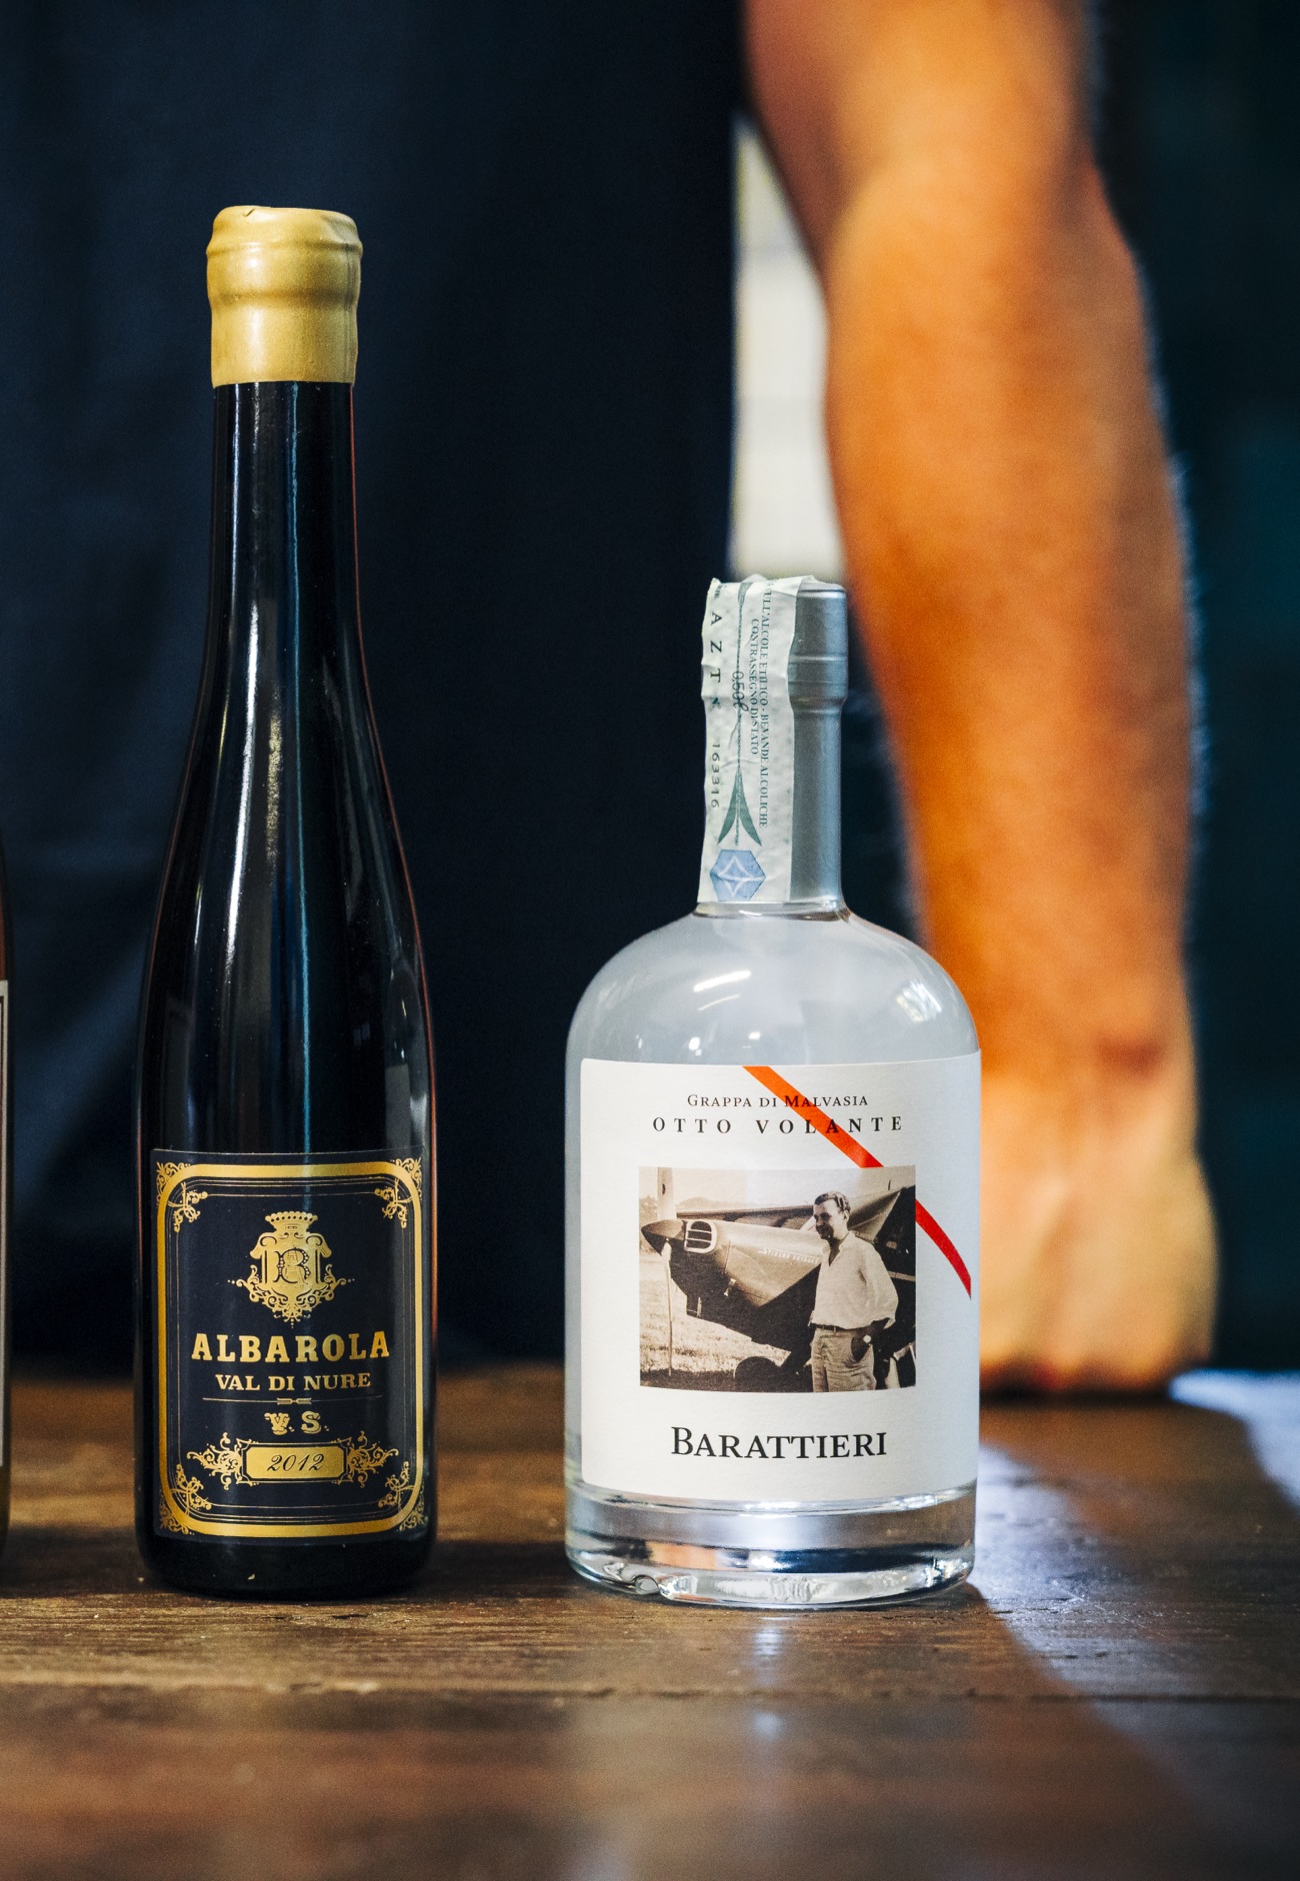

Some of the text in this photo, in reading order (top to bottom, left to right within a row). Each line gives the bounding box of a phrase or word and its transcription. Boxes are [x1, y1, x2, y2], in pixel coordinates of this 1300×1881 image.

[760, 766, 769, 828] ALCOLICHE
[687, 1094, 868, 1107] GRAPPA DI MALVASIA
[653, 1116, 902, 1135] OTTO VOLANTE
[191, 1330, 390, 1363] ALBAROLA
[215, 1372, 371, 1391] VAL DI NURE
[671, 1427, 887, 1459] BARATTIERI
[267, 1453, 325, 1472] 2012
